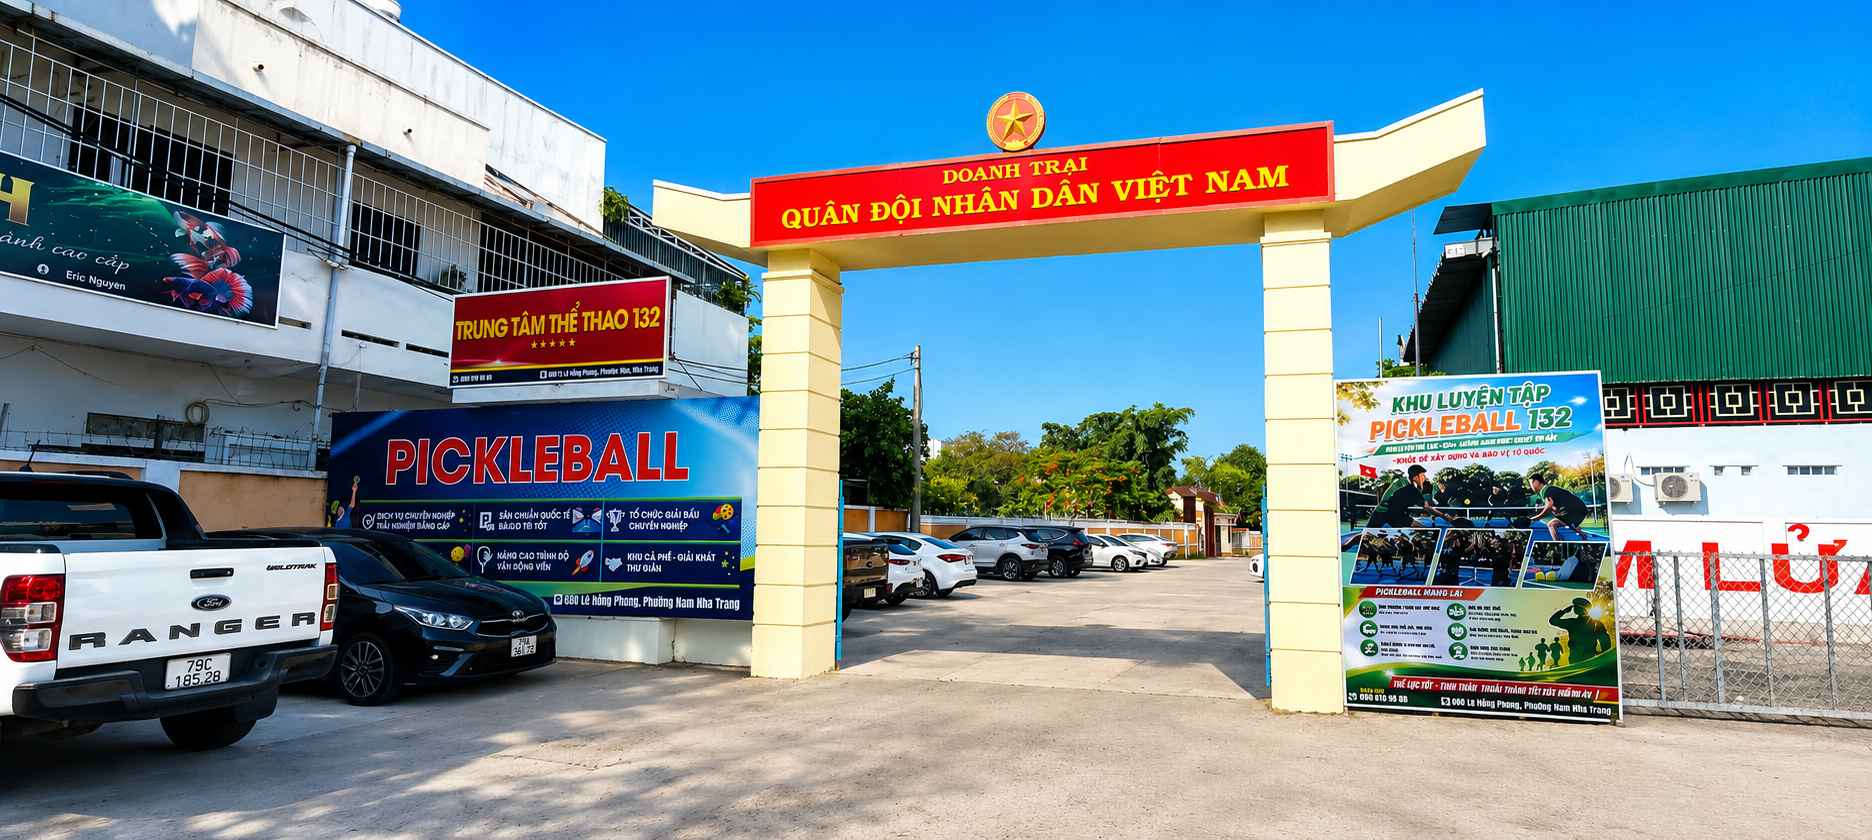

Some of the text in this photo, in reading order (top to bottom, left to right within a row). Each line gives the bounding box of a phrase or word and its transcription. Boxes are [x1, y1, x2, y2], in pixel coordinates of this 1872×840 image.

[943, 157, 1088, 184] DOANH TRẠI
[781, 165, 1289, 229] QUÂN ĐỘI NHÂN DÂN VIỆT NAM
[52, 246, 87, 260] cao
[66, 270, 126, 290] Eric Nguyen
[456, 301, 660, 340] TRUNG TÂM THỂ THAO 132
[1391, 380, 1551, 414] KHU LUYỆN TẬP
[1369, 410, 1520, 442] PICKLEBALL
[1527, 406, 1572, 430] 132
[385, 431, 690, 486] PICKLEBALL
[518, 552, 535, 560] CAO
[627, 552, 643, 561] KHU
[715, 597, 740, 611] Trang
[69, 612, 315, 650] RANGER
[186, 658, 212, 672] 79C
[175, 670, 221, 688] 185.28
